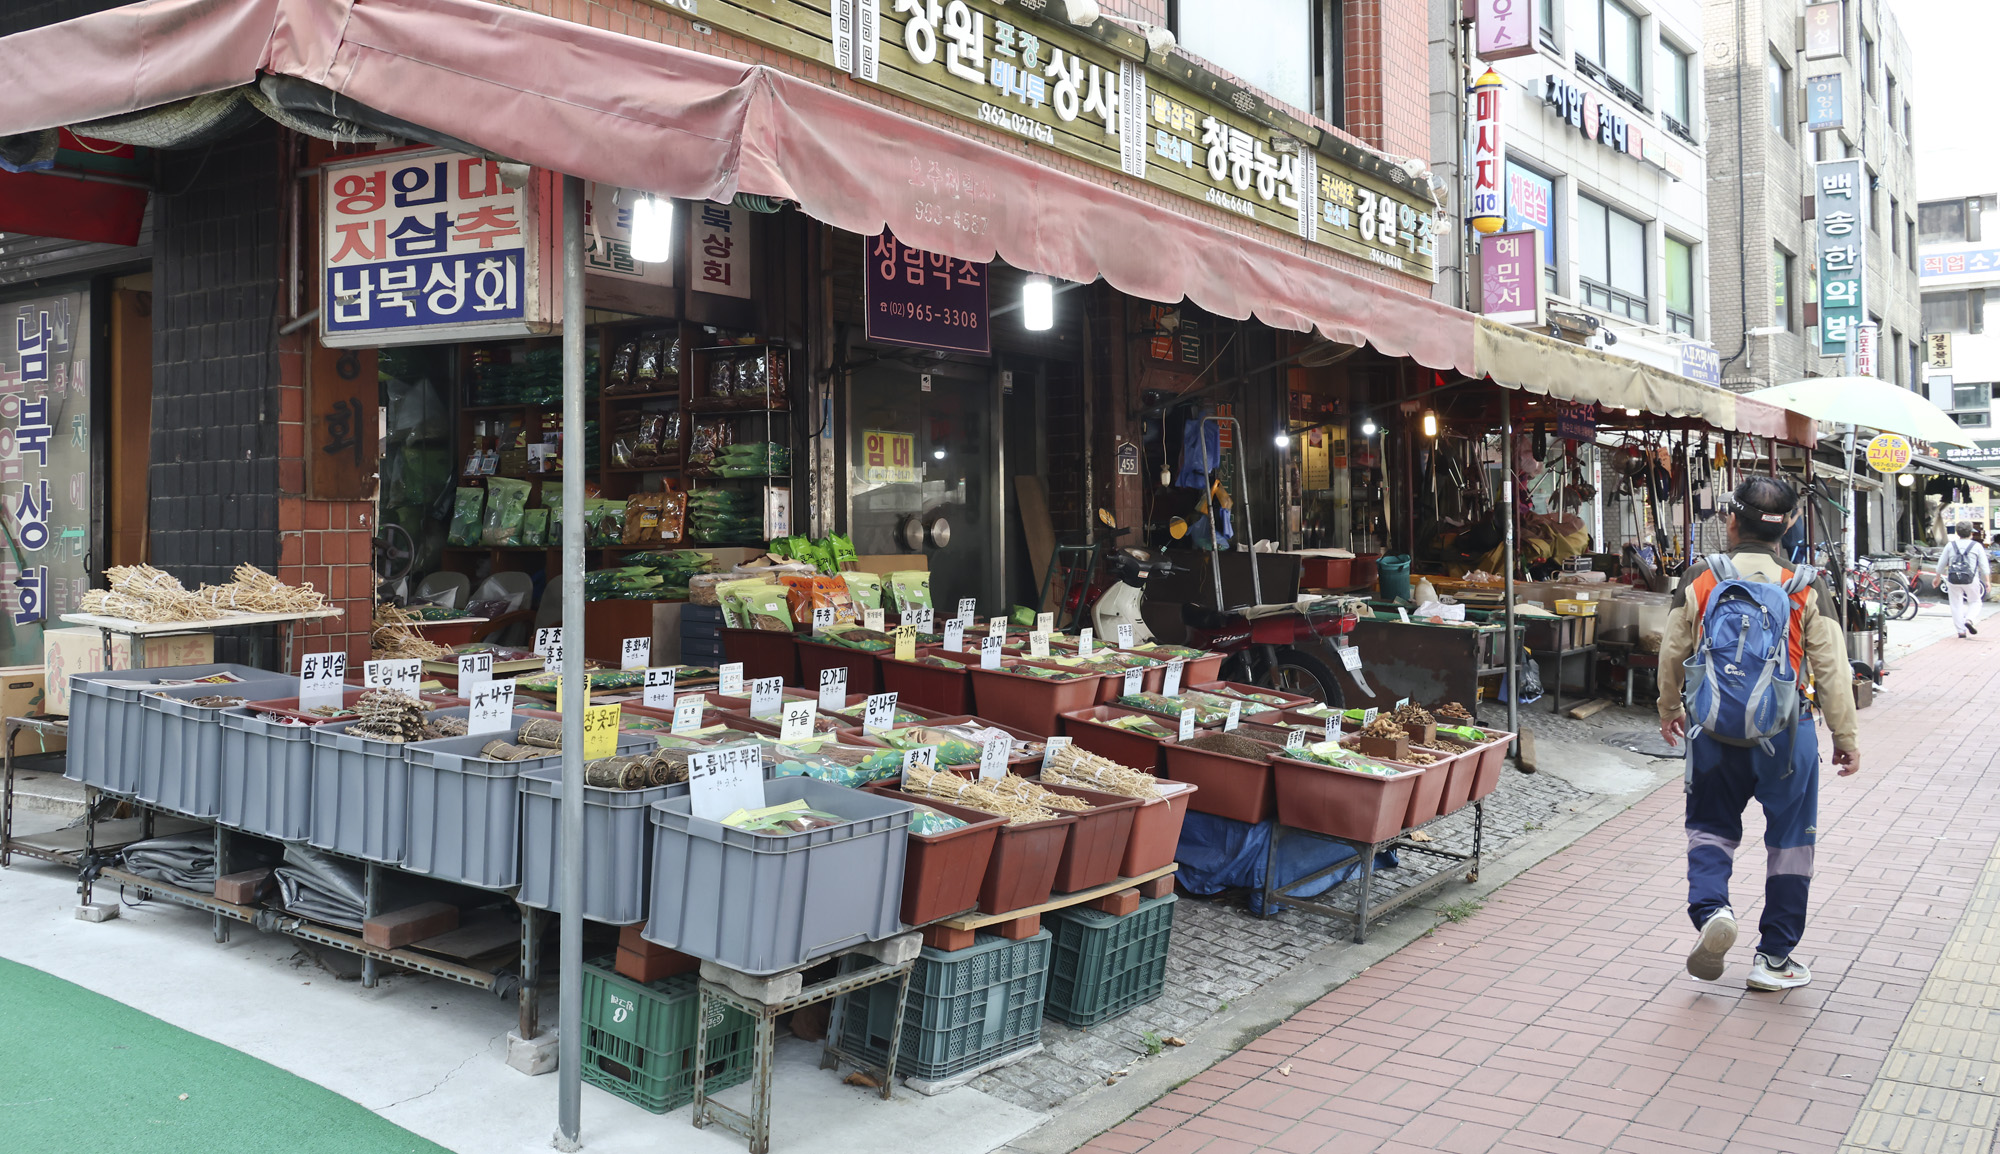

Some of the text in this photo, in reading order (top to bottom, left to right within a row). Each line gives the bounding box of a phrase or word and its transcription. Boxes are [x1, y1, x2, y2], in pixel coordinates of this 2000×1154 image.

[990, 57, 1045, 109] 비니루
[995, 20, 1039, 69] 포장
[1044, 48, 1119, 135] 상사
[1154, 128, 1193, 169] 도소매
[1202, 115, 1300, 210] 청룡농산
[386, 161, 454, 258] 인삼
[1511, 173, 1548, 227] 체험실
[330, 170, 387, 263] 영지
[586, 239, 635, 273] 산물
[1924, 254, 1966, 273] 직업
[1495, 237, 1521, 307] 혜민서
[333, 254, 518, 324] 남북상회
[867, 434, 910, 469] 임대
[1876, 438, 1903, 449] 경동
[1121, 458, 1135, 471] 455
[1868, 447, 1908, 464] 고시텔
[15, 310, 53, 627] 남북상회
[905, 608, 931, 624] 어성초
[946, 619, 964, 632] 구기자
[539, 628, 562, 646] 감초
[897, 626, 916, 640] 구기자
[982, 635, 1003, 650] 오미자
[461, 655, 491, 674] 제피
[645, 669, 674, 688] 모과
[755, 679, 782, 695] 마가목
[820, 667, 847, 687] 오가피
[868, 694, 897, 716] 엄나무
[788, 709, 810, 727] 우슬
